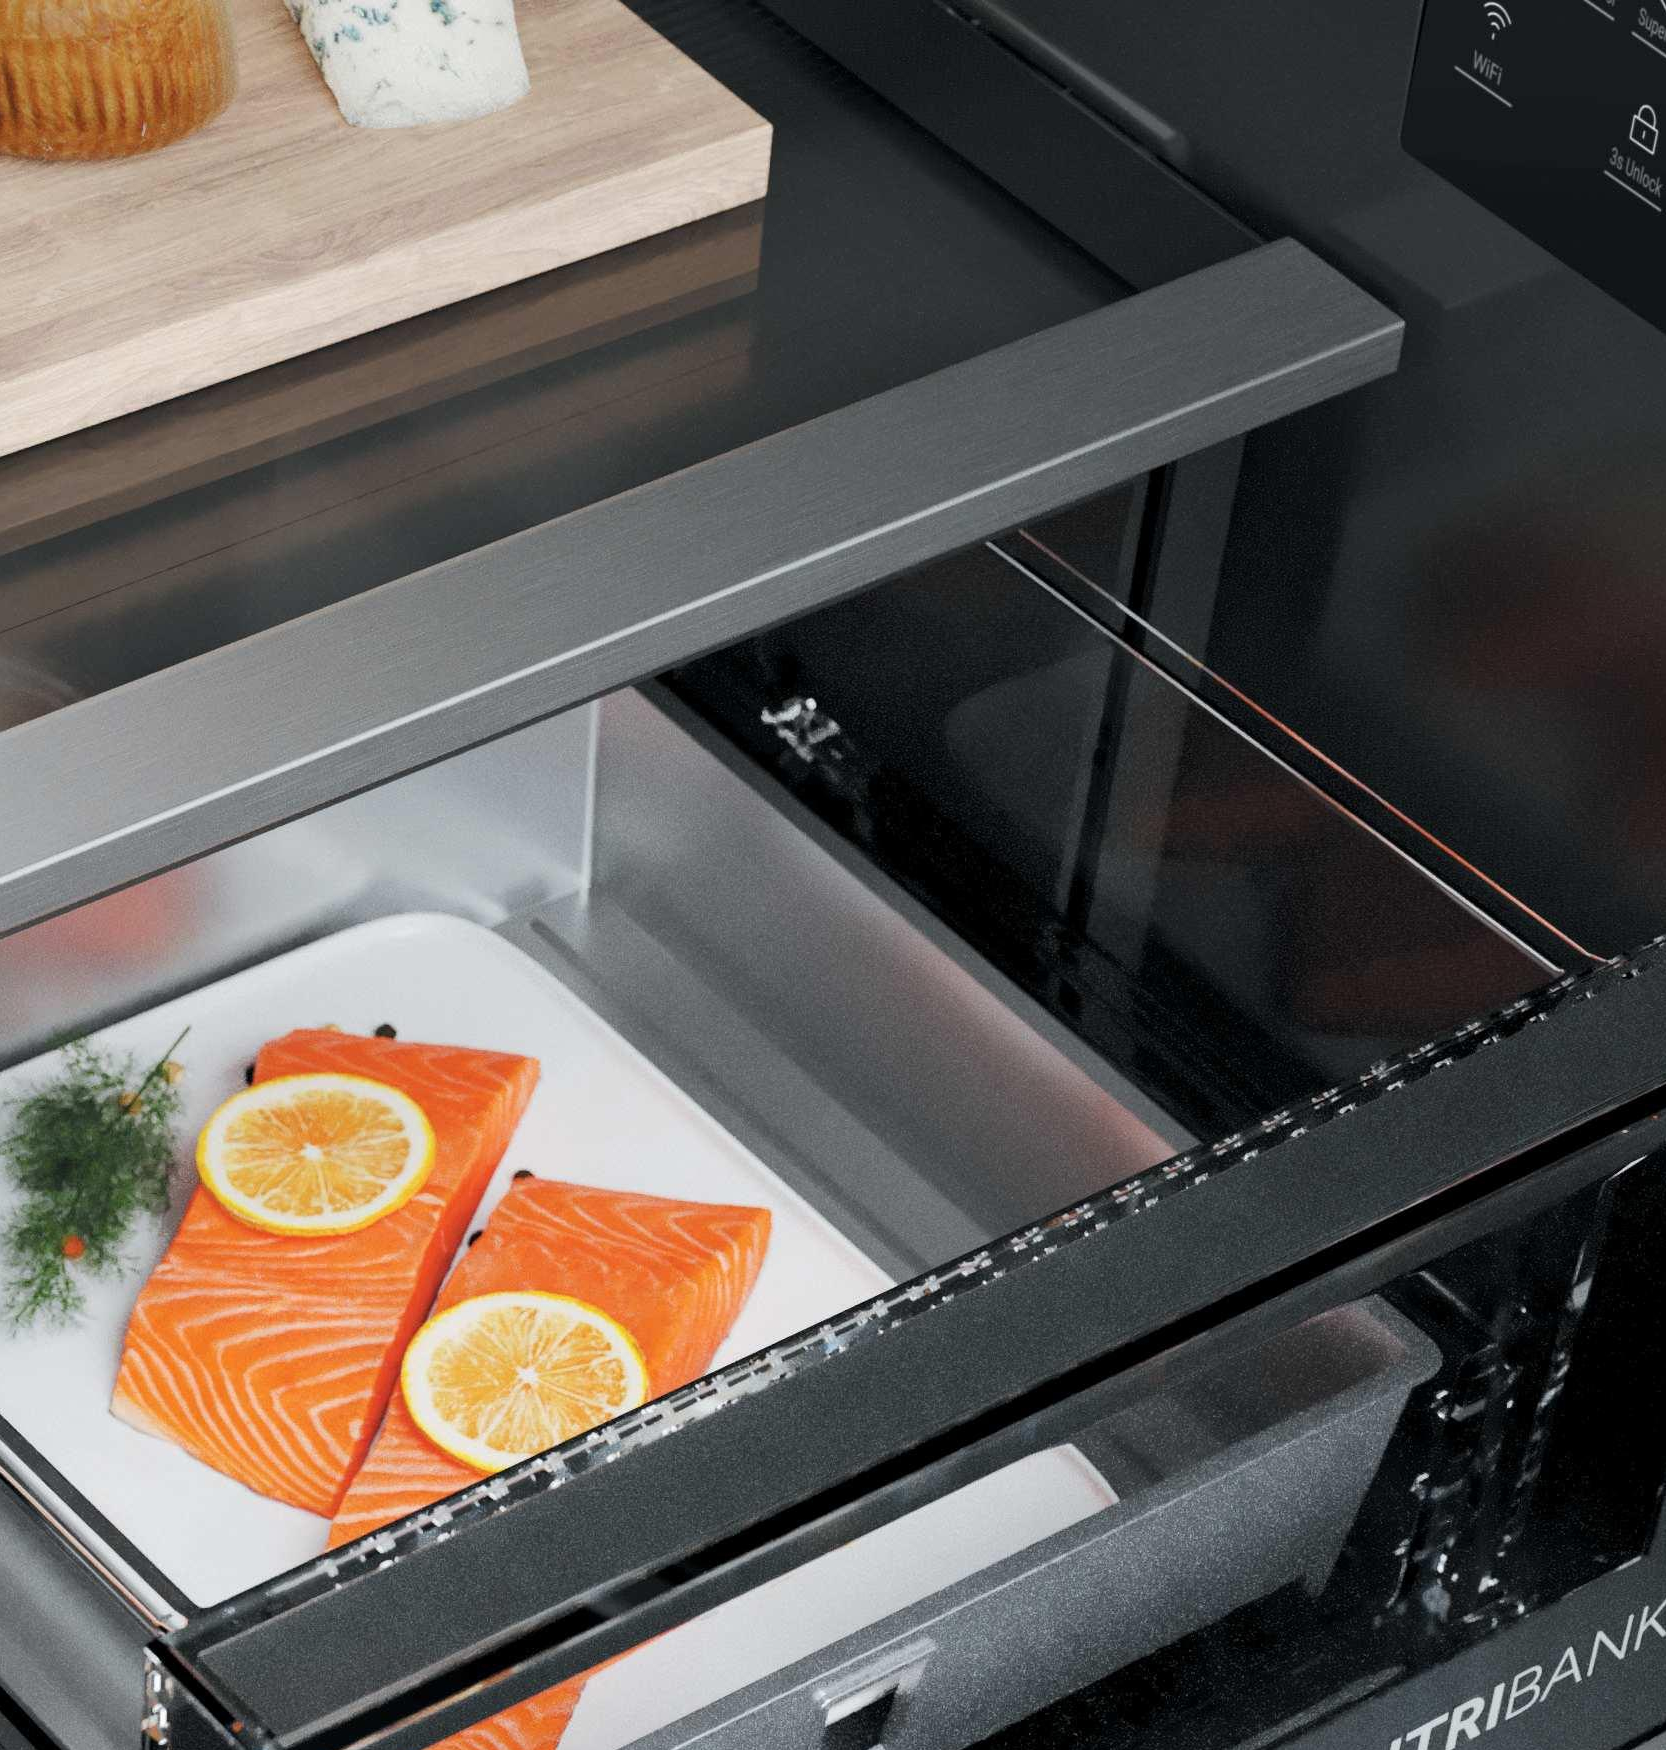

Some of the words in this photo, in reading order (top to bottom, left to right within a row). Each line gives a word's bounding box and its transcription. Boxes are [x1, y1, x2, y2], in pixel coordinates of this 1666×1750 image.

[1473, 48, 1503, 86] WiFi
[1608, 146, 1624, 170] 3s
[1625, 156, 1664, 198] Unlock
